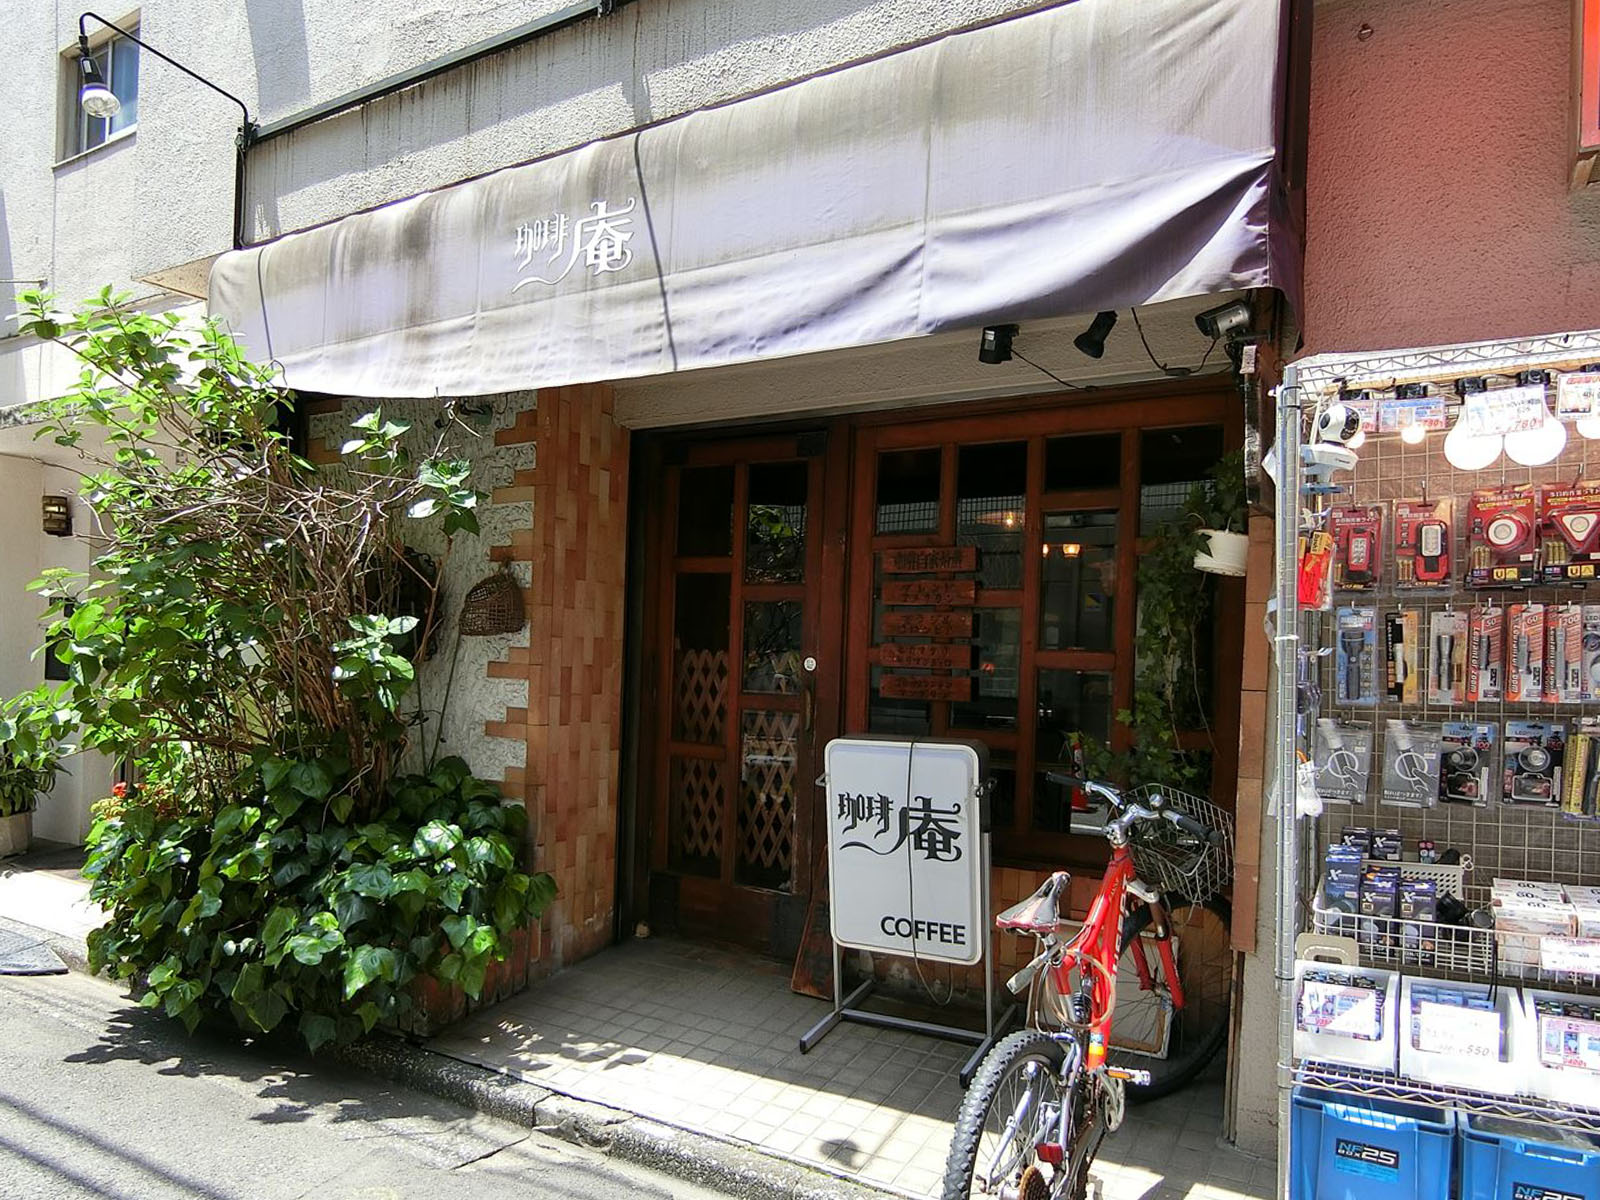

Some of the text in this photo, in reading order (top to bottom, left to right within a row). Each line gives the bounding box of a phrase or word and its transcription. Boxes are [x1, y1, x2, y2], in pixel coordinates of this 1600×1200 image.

[512, 197, 636, 294] 珈琲庵
[837, 792, 963, 862] 珈琲庵
[880, 915, 966, 945] COFFEE
[1338, 1142, 1364, 1155] NF
[1362, 1146, 1397, 1165] 25
[1516, 1186, 1543, 1197] NF
